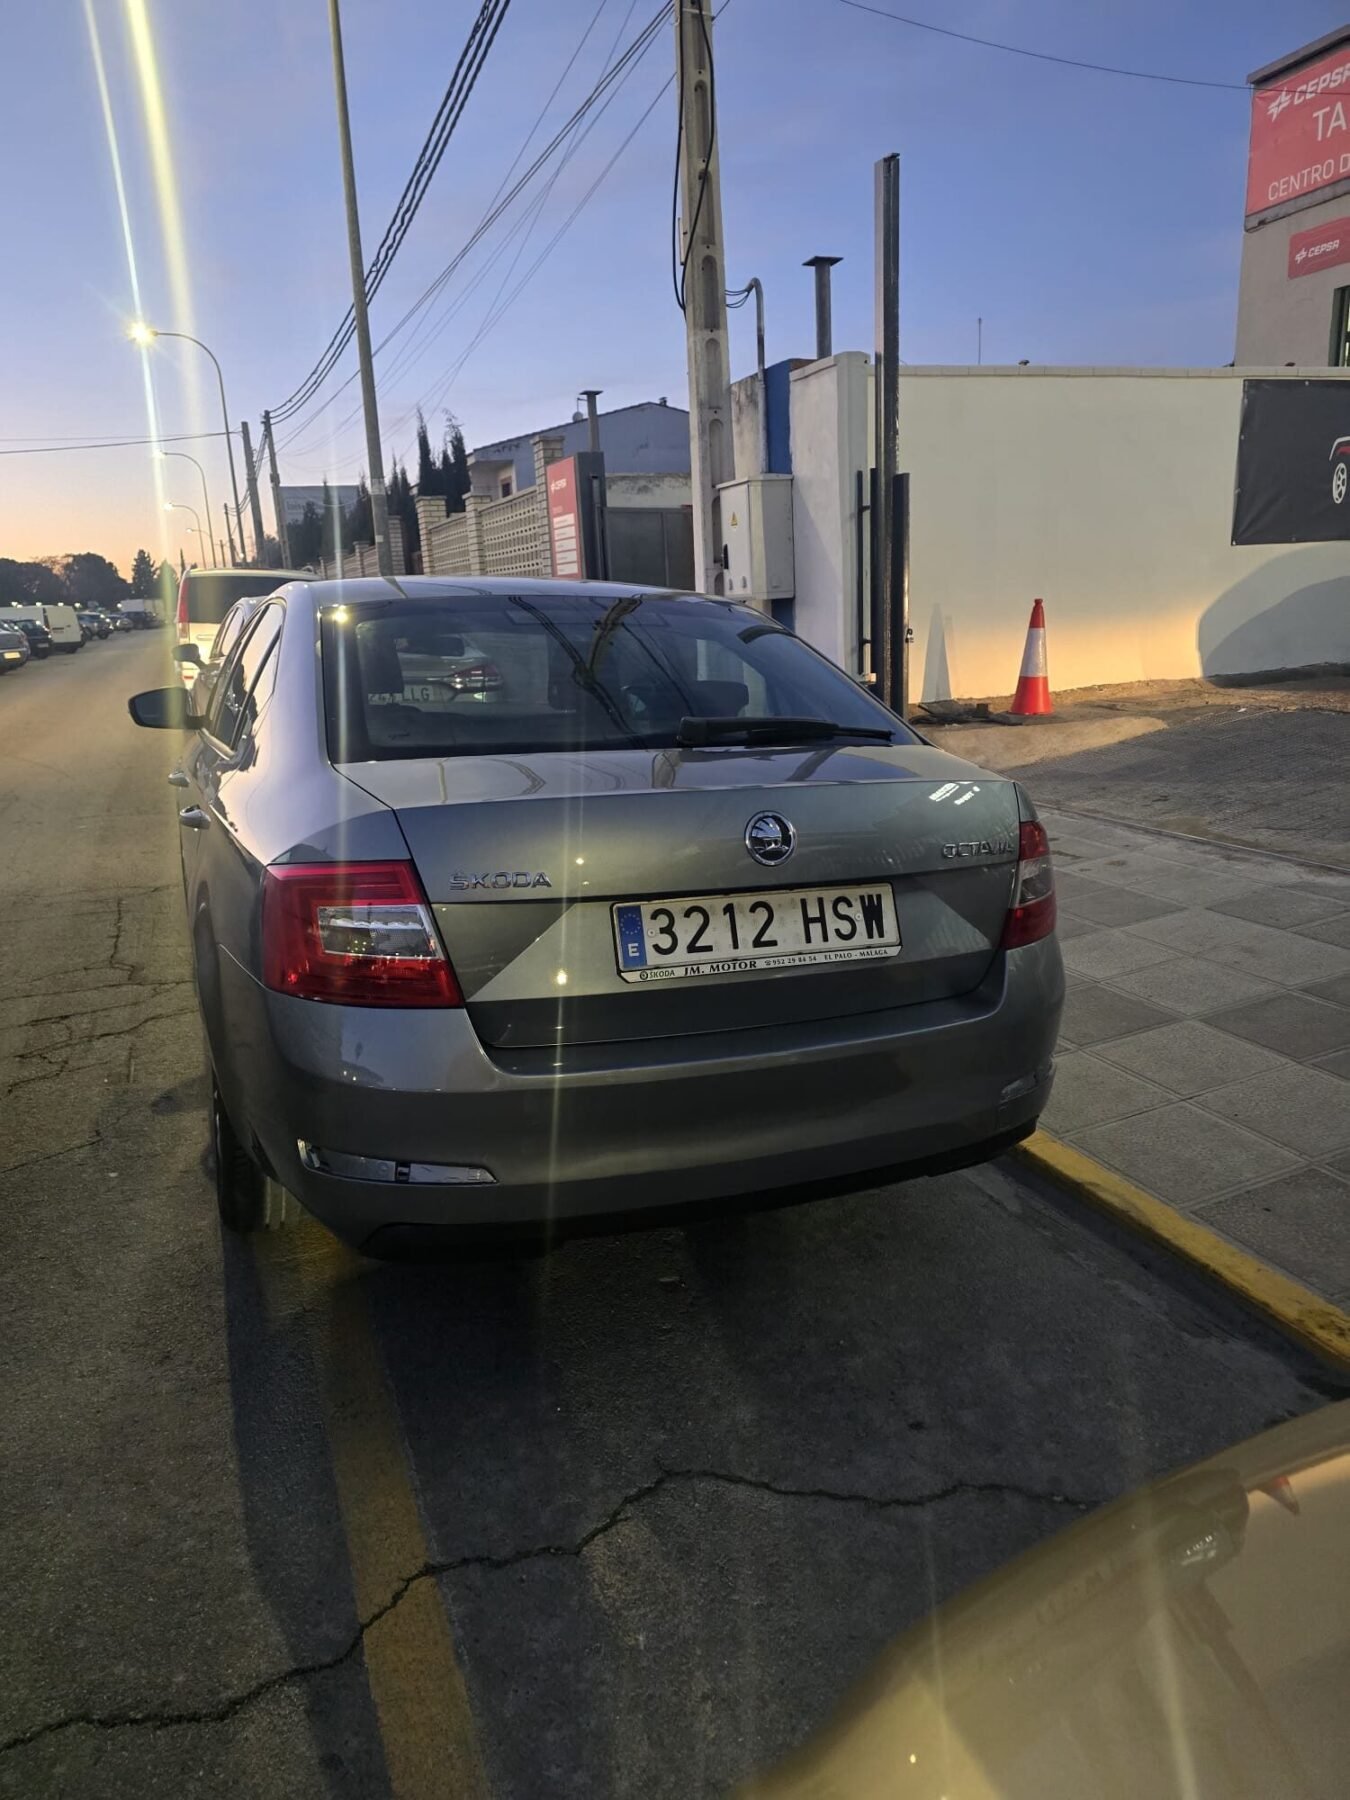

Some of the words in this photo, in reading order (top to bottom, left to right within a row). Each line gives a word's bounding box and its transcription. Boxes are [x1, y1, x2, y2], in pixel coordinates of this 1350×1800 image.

[1312, 101, 1347, 142] TA
[1268, 159, 1335, 201] CENTRO
[1308, 239, 1340, 258] CEPSA
[650, 901, 778, 956] 3212
[800, 894, 885, 944] HSW
[628, 943, 640, 957] E
[709, 960, 757, 973] MOTOR
[834, 952, 852, 960] PALO
